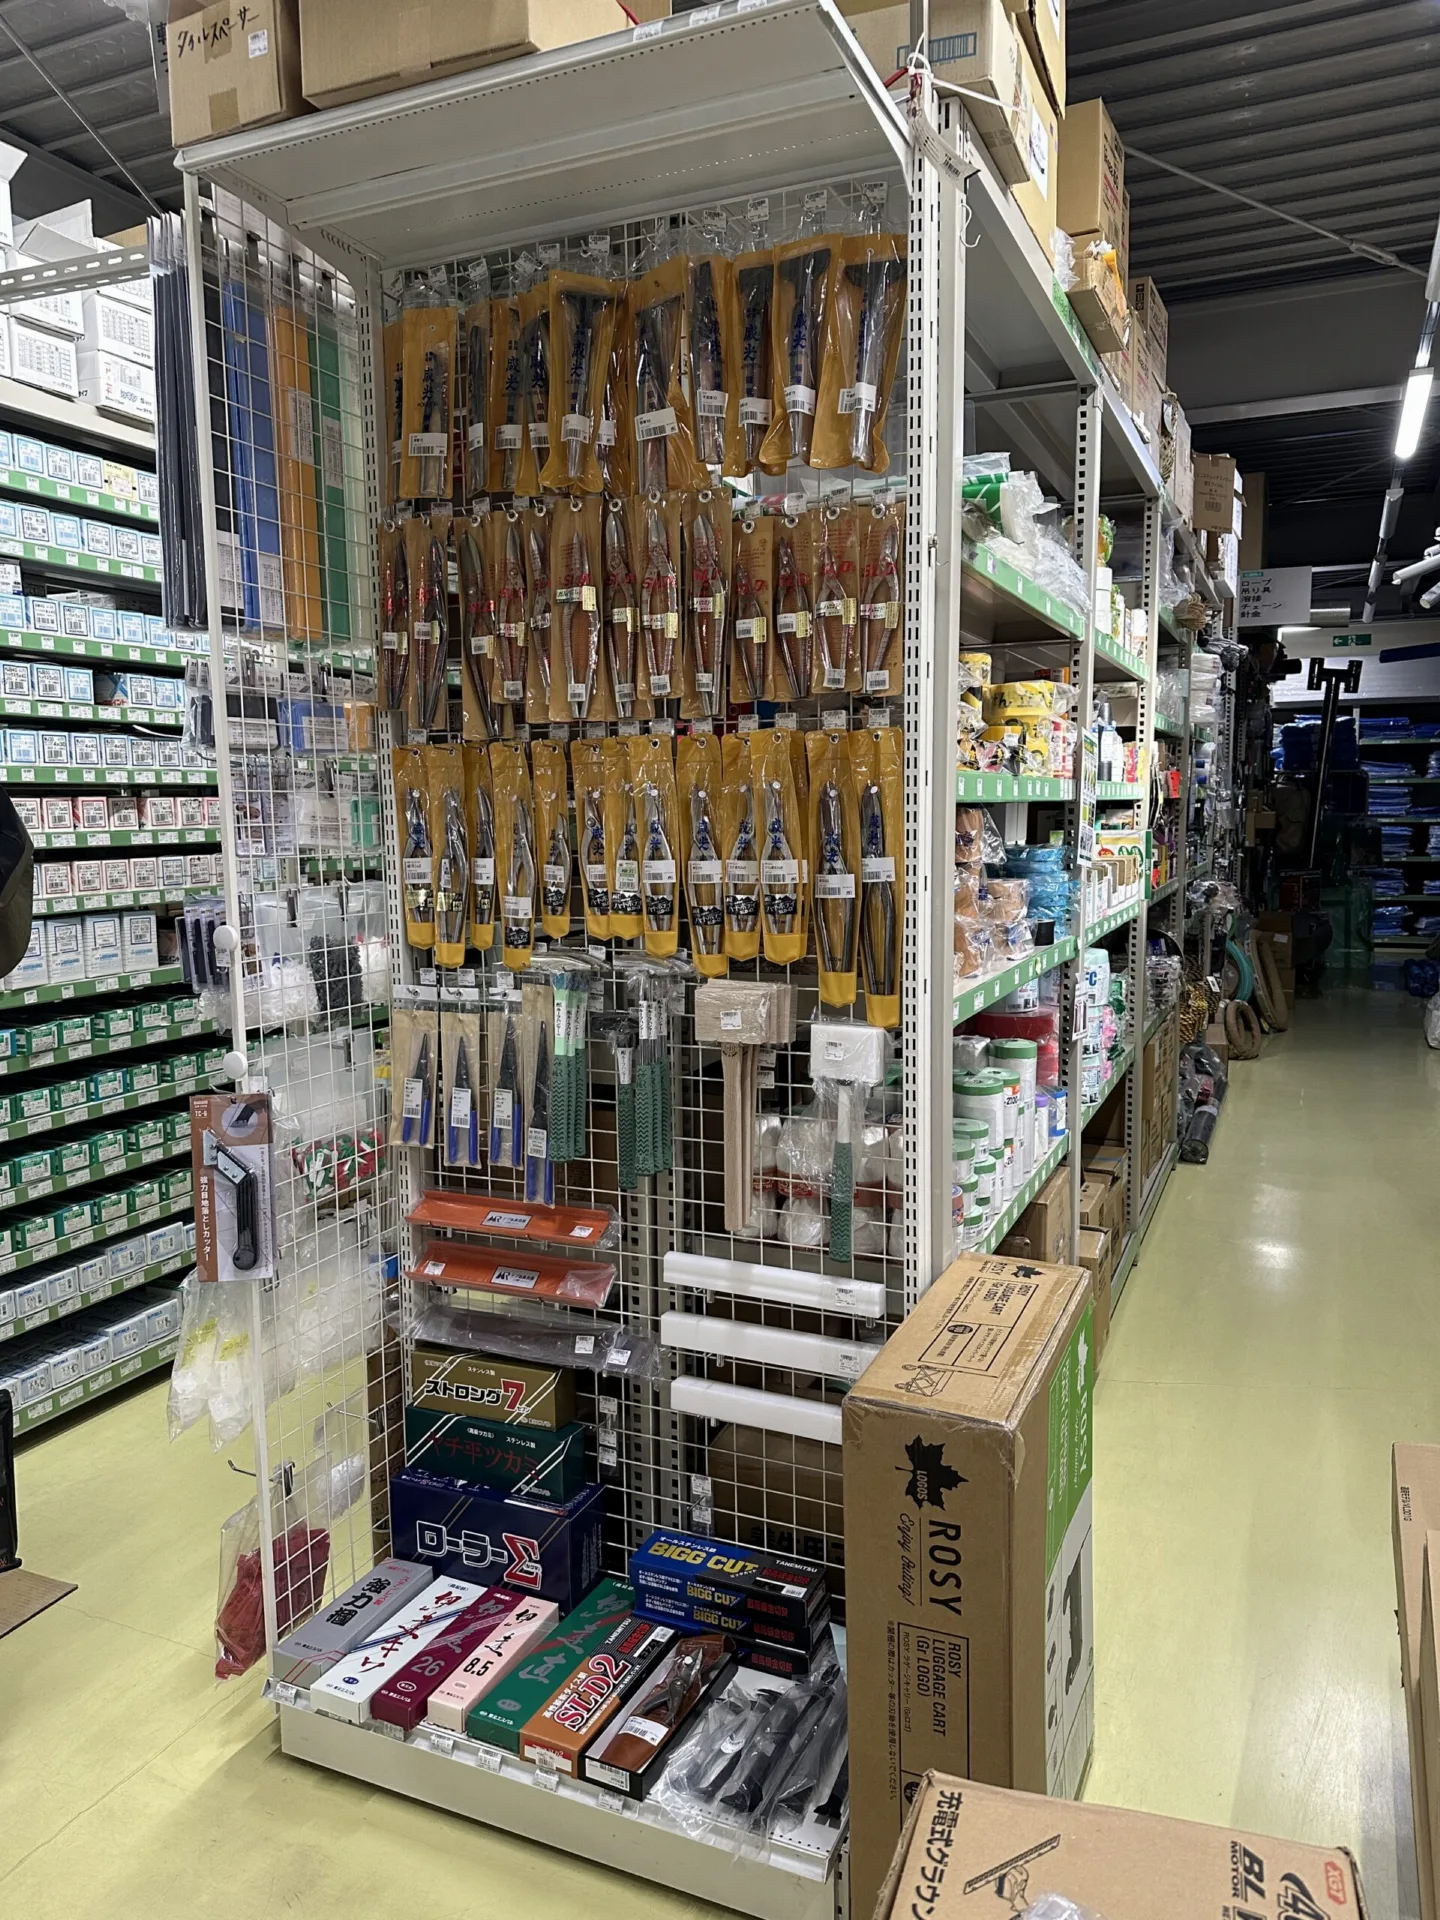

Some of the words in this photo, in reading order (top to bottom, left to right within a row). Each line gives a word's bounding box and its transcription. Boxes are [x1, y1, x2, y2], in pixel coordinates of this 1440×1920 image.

[1241, 578, 1272, 587] ロープ
[1241, 586, 1272, 595] 吊り具
[1241, 595, 1262, 603] 溶接
[1241, 602, 1282, 611] チェーン
[1241, 611, 1262, 619] 針金
[199, 1176, 212, 1262] 強力目地落としカッター
[468, 1366, 496, 1376] ステンレス製
[506, 1436, 536, 1449] ステンレス製
[916, 1469, 928, 1500] LOGOS
[897, 1512, 915, 1554] Enjoy
[648, 1541, 707, 1565] BIGG
[706, 1555, 759, 1574] CUT
[775, 1559, 818, 1573] TANEMITSU
[928, 1519, 962, 1617] ROSY
[686, 1585, 713, 1603] BIGG
[714, 1594, 737, 1606] CUT
[693, 1608, 720, 1626] BIGG
[720, 1615, 743, 1630] CUT
[604, 1618, 632, 1645] TANEMITSU
[916, 1635, 931, 1656] (Gr
[410, 1656, 445, 1677] 26
[463, 1657, 494, 1677] 8.5
[932, 1638, 946, 1700] LUGGAGE
[947, 1641, 962, 1679] ROSY
[916, 1657, 932, 1698] LOGO)
[553, 1653, 632, 1732] SLD2
[932, 1700, 946, 1738] CART
[1230, 1840, 1241, 1899] MOTOR
[1242, 1845, 1267, 1903] BL
